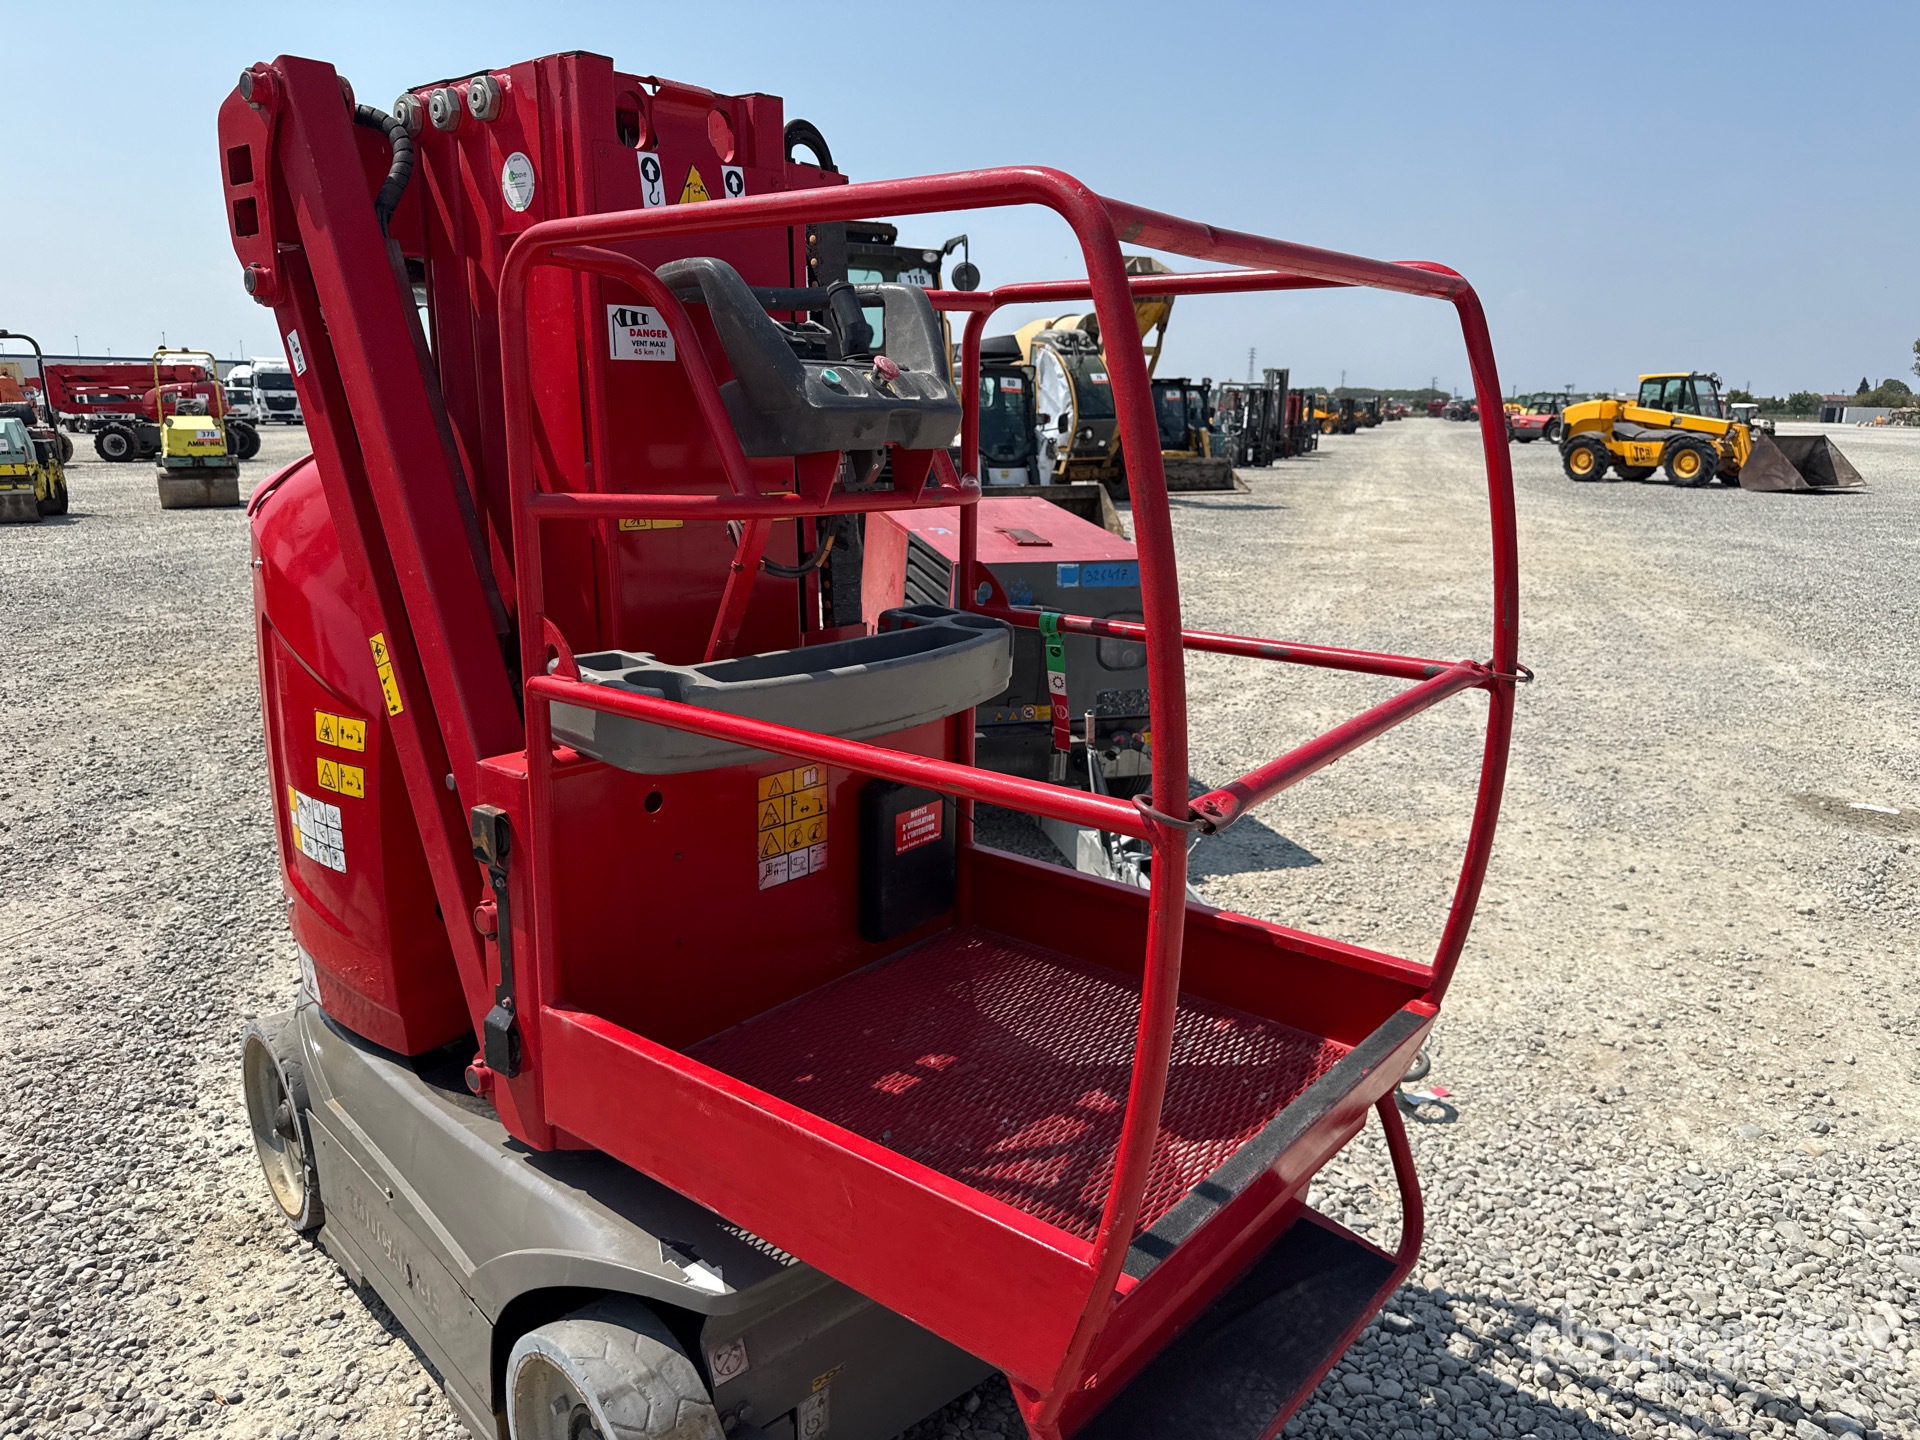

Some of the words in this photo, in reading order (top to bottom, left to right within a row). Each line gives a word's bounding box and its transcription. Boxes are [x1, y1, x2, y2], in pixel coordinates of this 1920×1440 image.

[908, 275, 925, 284] 118
[630, 328, 667, 338] DANGER
[644, 348, 654, 356] km
[1634, 446, 1650, 462] JCB
[911, 806, 927, 819] NOTICE
[902, 813, 936, 832] D'UTILISATION
